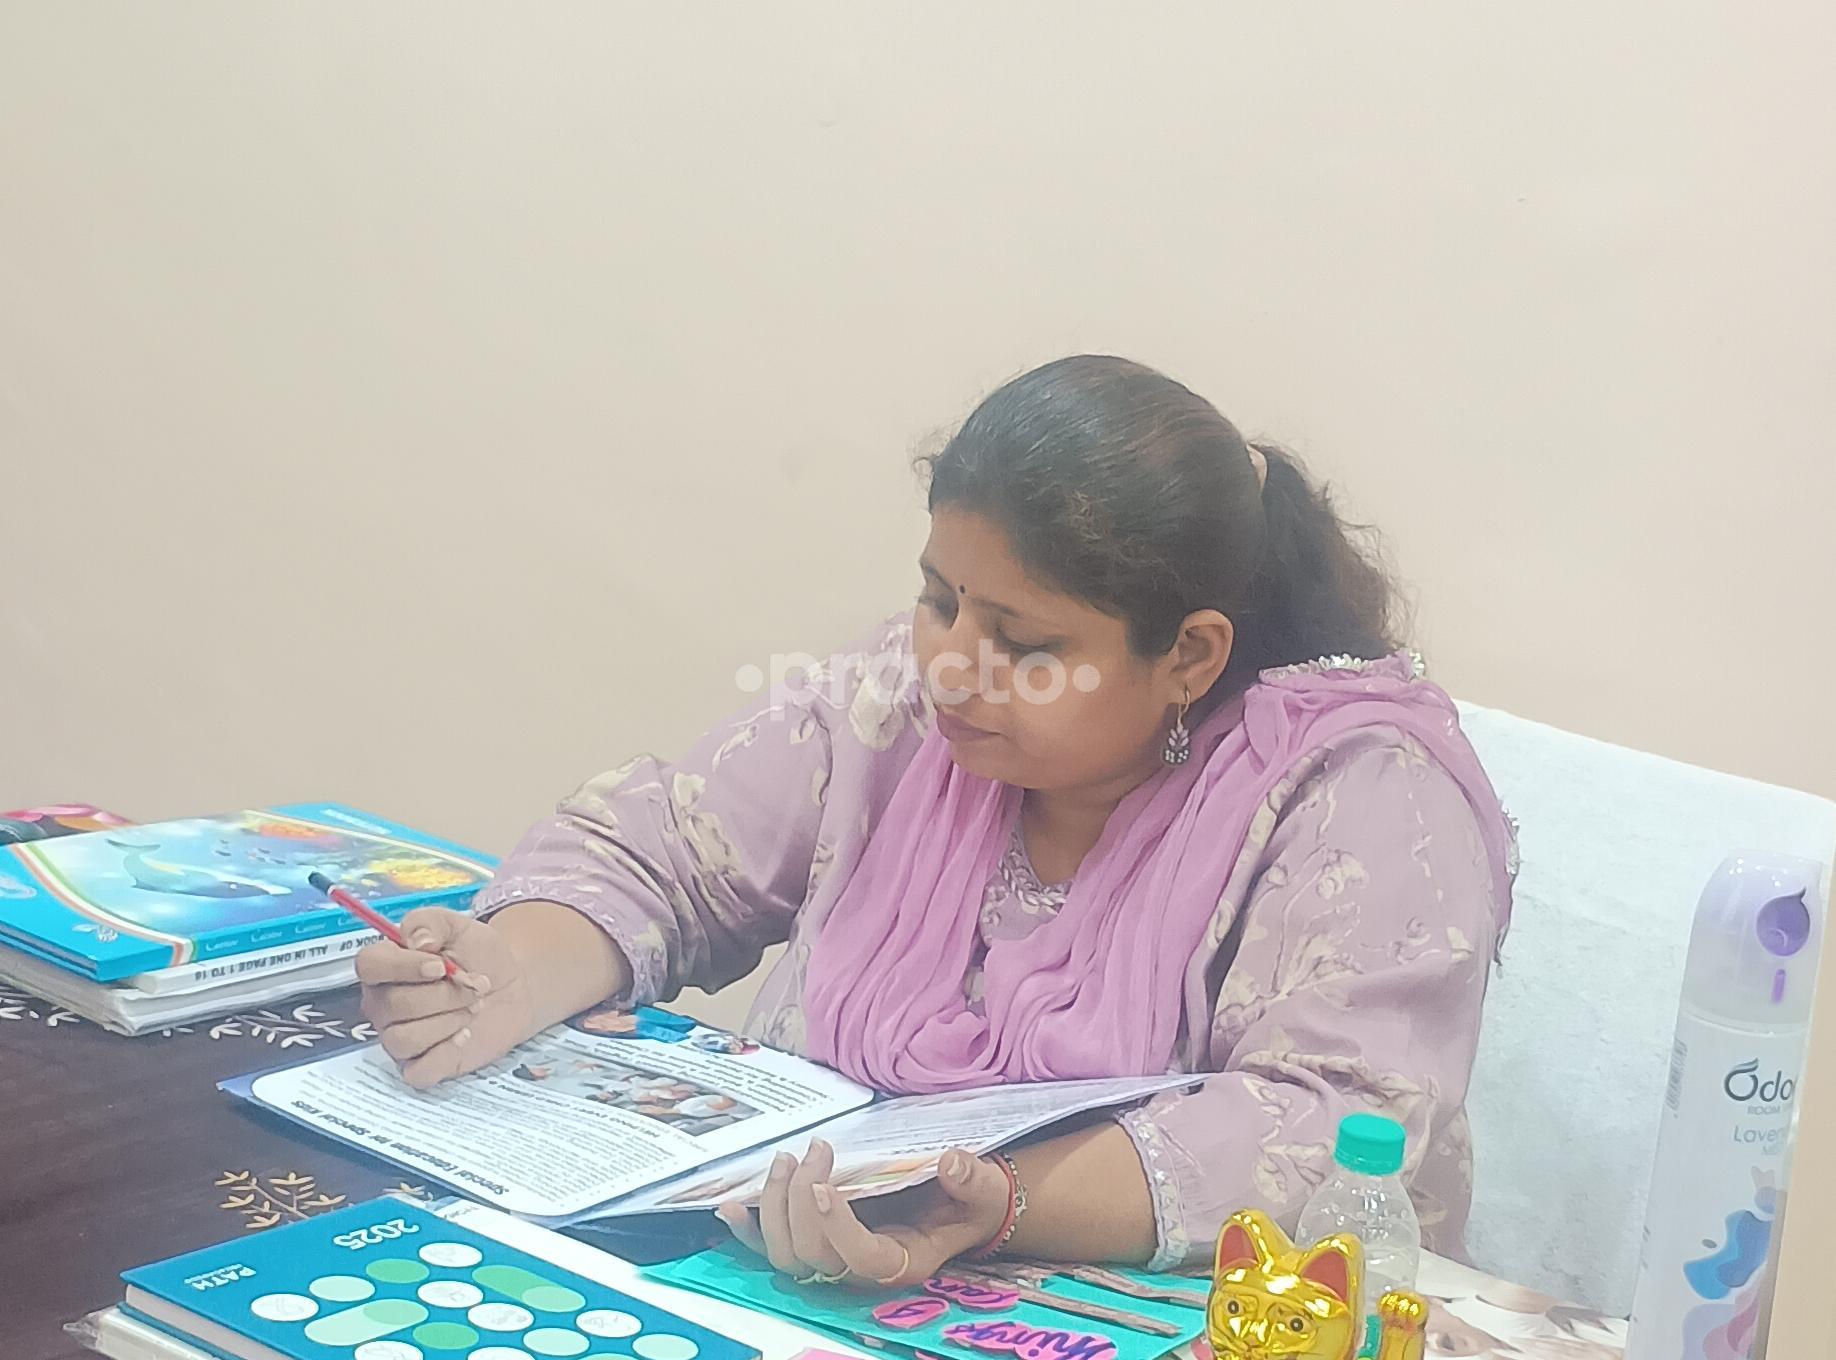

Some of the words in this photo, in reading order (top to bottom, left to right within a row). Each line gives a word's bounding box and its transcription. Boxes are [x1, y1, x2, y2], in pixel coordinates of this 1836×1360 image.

[310, 945, 328, 957] ALL
[339, 941, 353, 951] OF
[270, 954, 291, 966] ONE
[295, 950, 307, 960] IN
[239, 958, 267, 973] PAGE
[211, 968, 226, 978] TO
[1724, 1058, 1796, 1102] Odo
[291, 1100, 322, 1114] Kids
[1747, 1105, 1781, 1116] ROOM
[319, 1114, 371, 1136] Special
[368, 1134, 392, 1144] for
[390, 1142, 458, 1172] Education
[455, 1169, 510, 1195] Special
[333, 1218, 420, 1250] 2025
[191, 1266, 256, 1290] PATH
